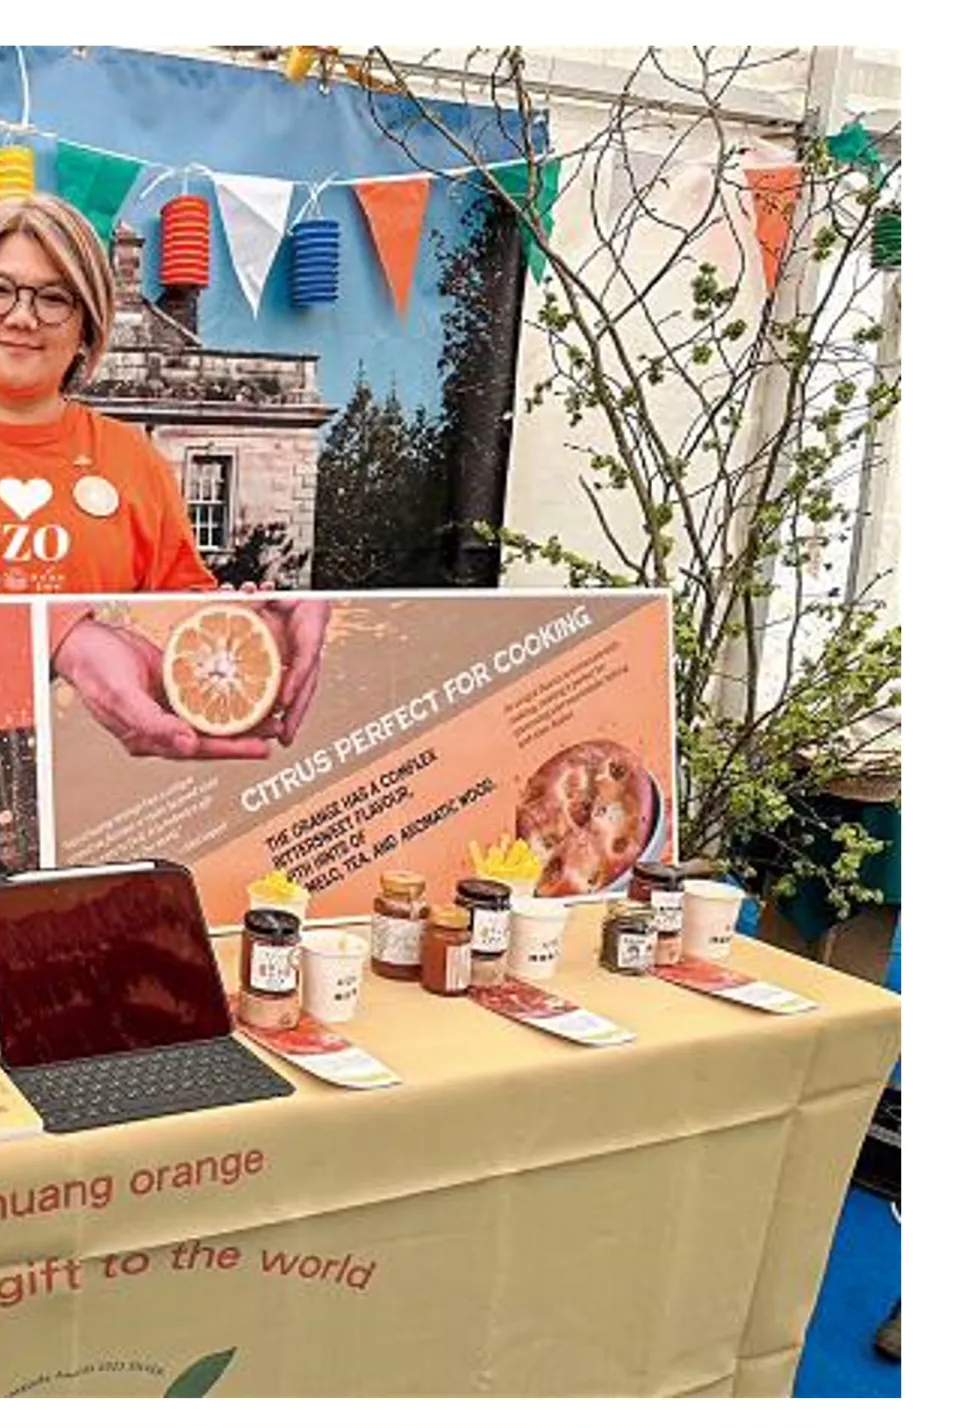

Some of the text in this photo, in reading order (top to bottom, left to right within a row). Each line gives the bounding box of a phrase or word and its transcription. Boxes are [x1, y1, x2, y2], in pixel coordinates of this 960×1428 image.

[241, 751, 334, 813] CITRUS
[336, 692, 441, 764] PERFECT
[442, 664, 492, 704] FOR
[493, 605, 593, 674] COOKING
[266, 831, 291, 852] THE
[293, 802, 341, 840] ORANGE
[342, 786, 371, 809] HAS
[380, 749, 438, 788] COMPLEX
[272, 818, 355, 868] BITTERSWEET
[304, 867, 344, 894] MELO,
[372, 834, 400, 860] AND
[400, 799, 460, 841] AROMATIC
[349, 831, 368, 850] OF
[130, 1149, 265, 1196] orange
[103, 1250, 150, 1278] to
[171, 1240, 242, 1270] the
[260, 1249, 378, 1291] world
